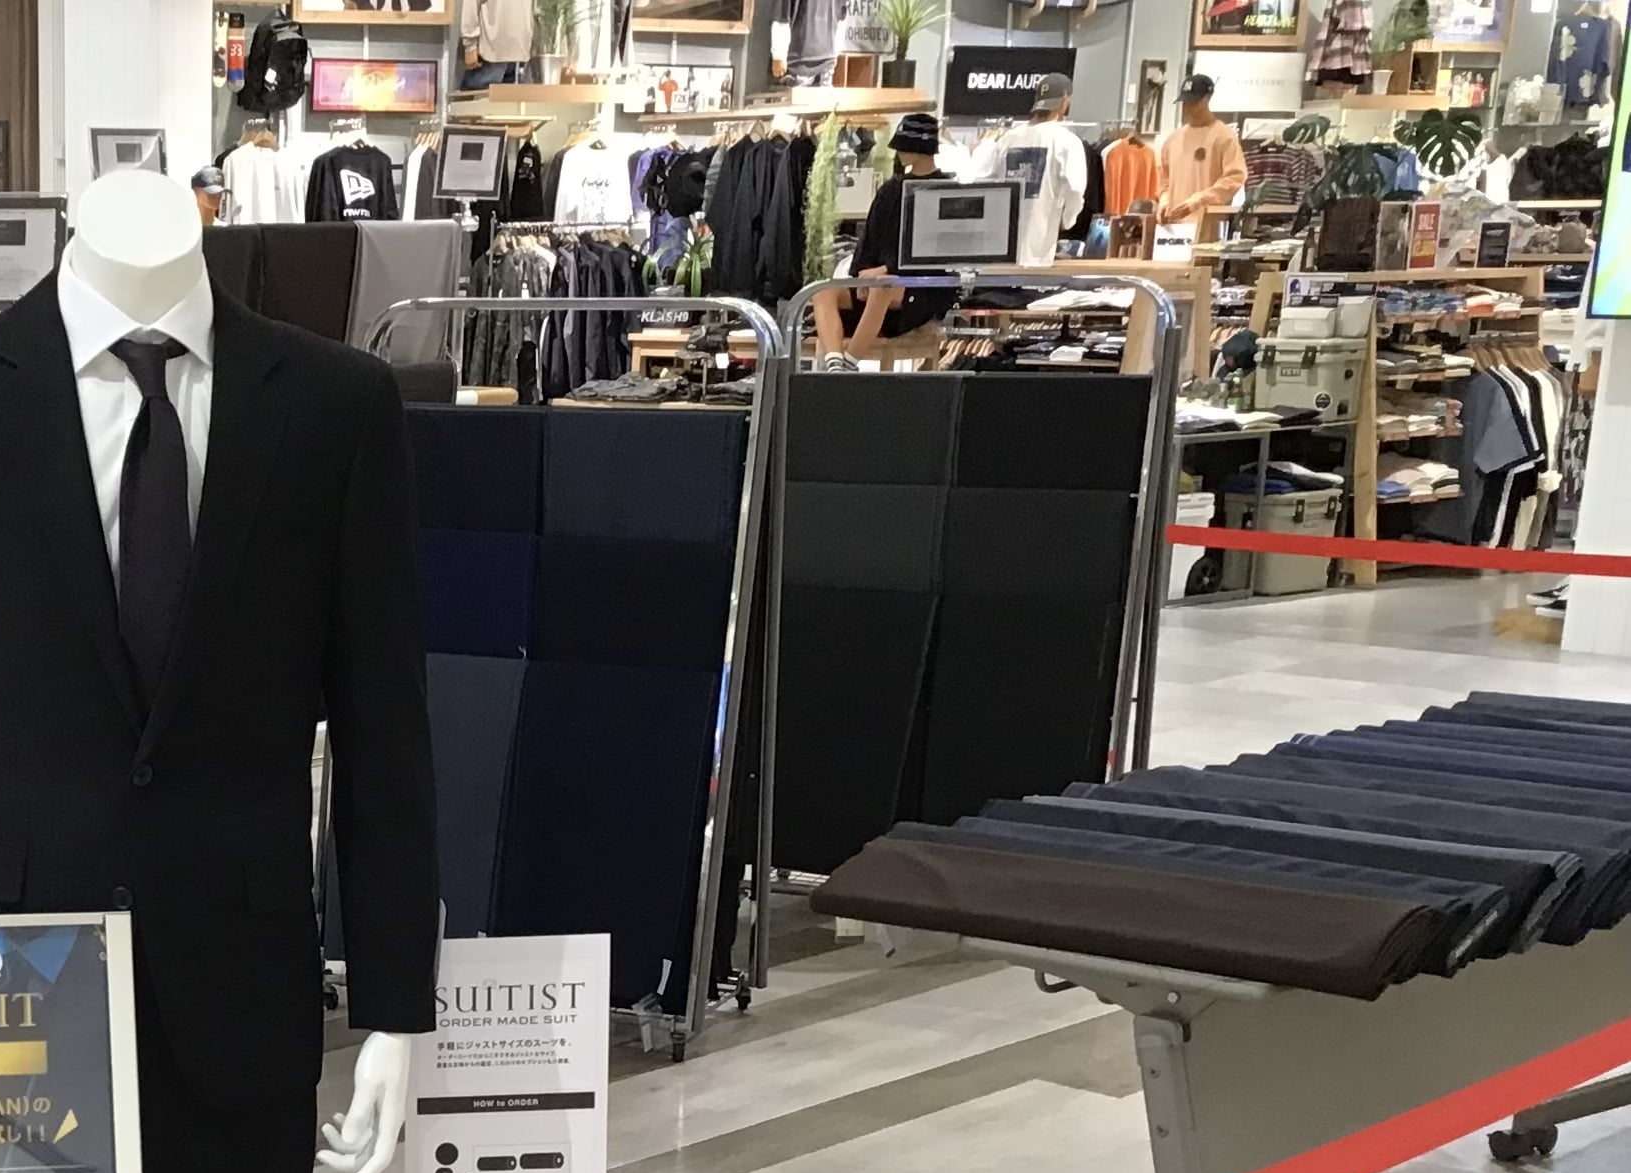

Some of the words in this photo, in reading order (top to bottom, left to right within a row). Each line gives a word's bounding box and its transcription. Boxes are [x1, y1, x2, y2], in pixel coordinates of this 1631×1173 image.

[967, 72, 1005, 89] DEAR
[435, 979, 585, 1014] SUITIST
[439, 1017, 492, 1028] ORDER
[497, 1015, 538, 1026] MADE
[543, 1014, 578, 1024] SUIT
